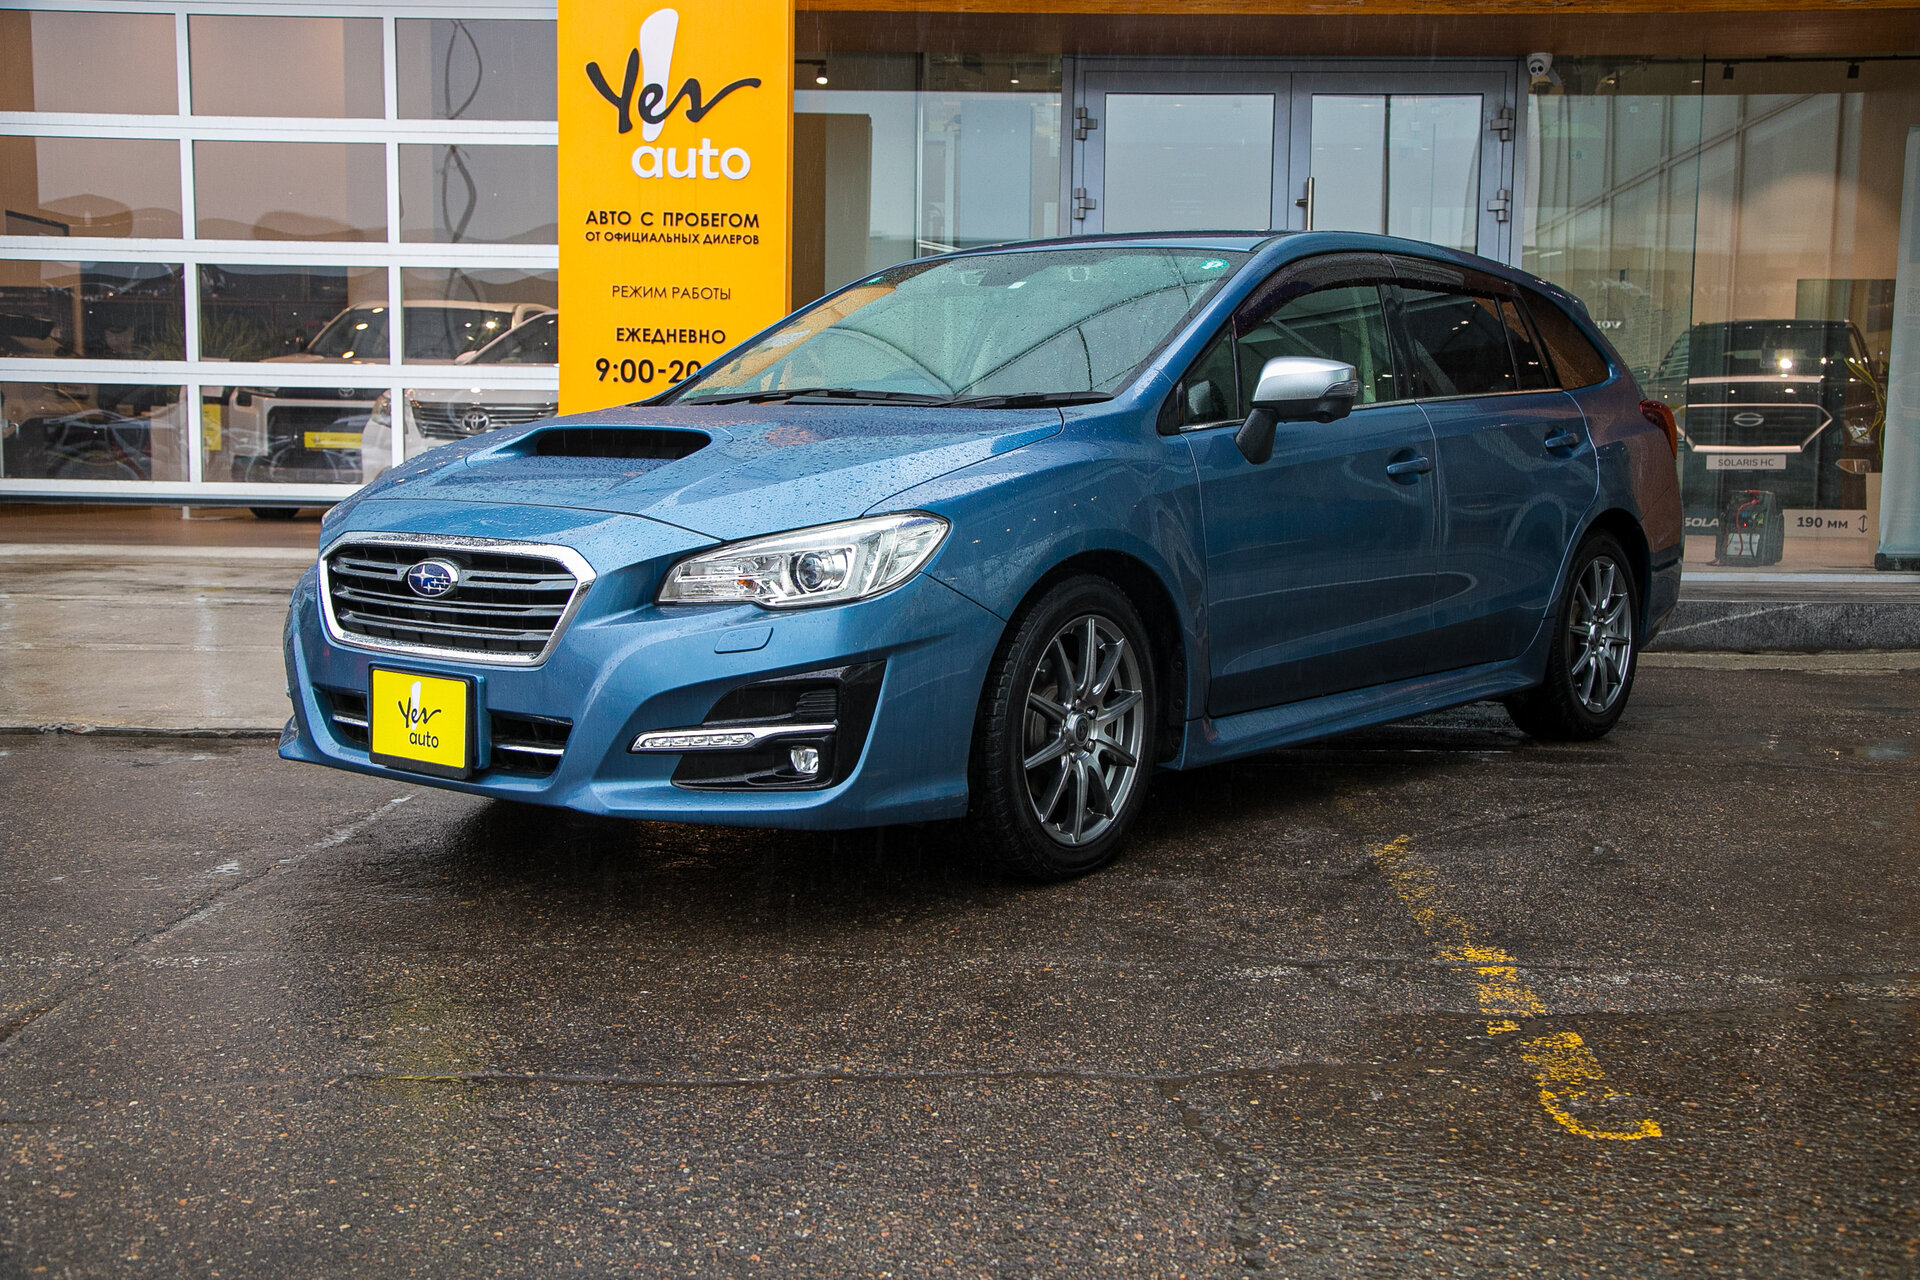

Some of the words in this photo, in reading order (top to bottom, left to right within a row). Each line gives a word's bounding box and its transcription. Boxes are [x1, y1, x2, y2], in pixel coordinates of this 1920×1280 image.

[586, 48, 761, 134] Yes
[632, 138, 751, 180] auto
[585, 210, 632, 226] АВТО
[640, 211, 654, 226] С
[662, 212, 760, 228] ПРОБЕГОМ
[585, 231, 601, 242] ОТ
[604, 230, 700, 244] ОФИЦИАЛЬНЫХ
[703, 233, 760, 245] ДИЛЕРОВ
[612, 285, 667, 299] РЕЖИМ
[671, 286, 731, 300] РАБОТЫ
[616, 327, 726, 344] ЕЖЕДНЕВНО
[1718, 458, 1758, 467] SOLARIS
[1760, 458, 1775, 467] HC
[1797, 516, 1824, 528] 190
[398, 697, 442, 728] Yes
[409, 731, 439, 748] auto
